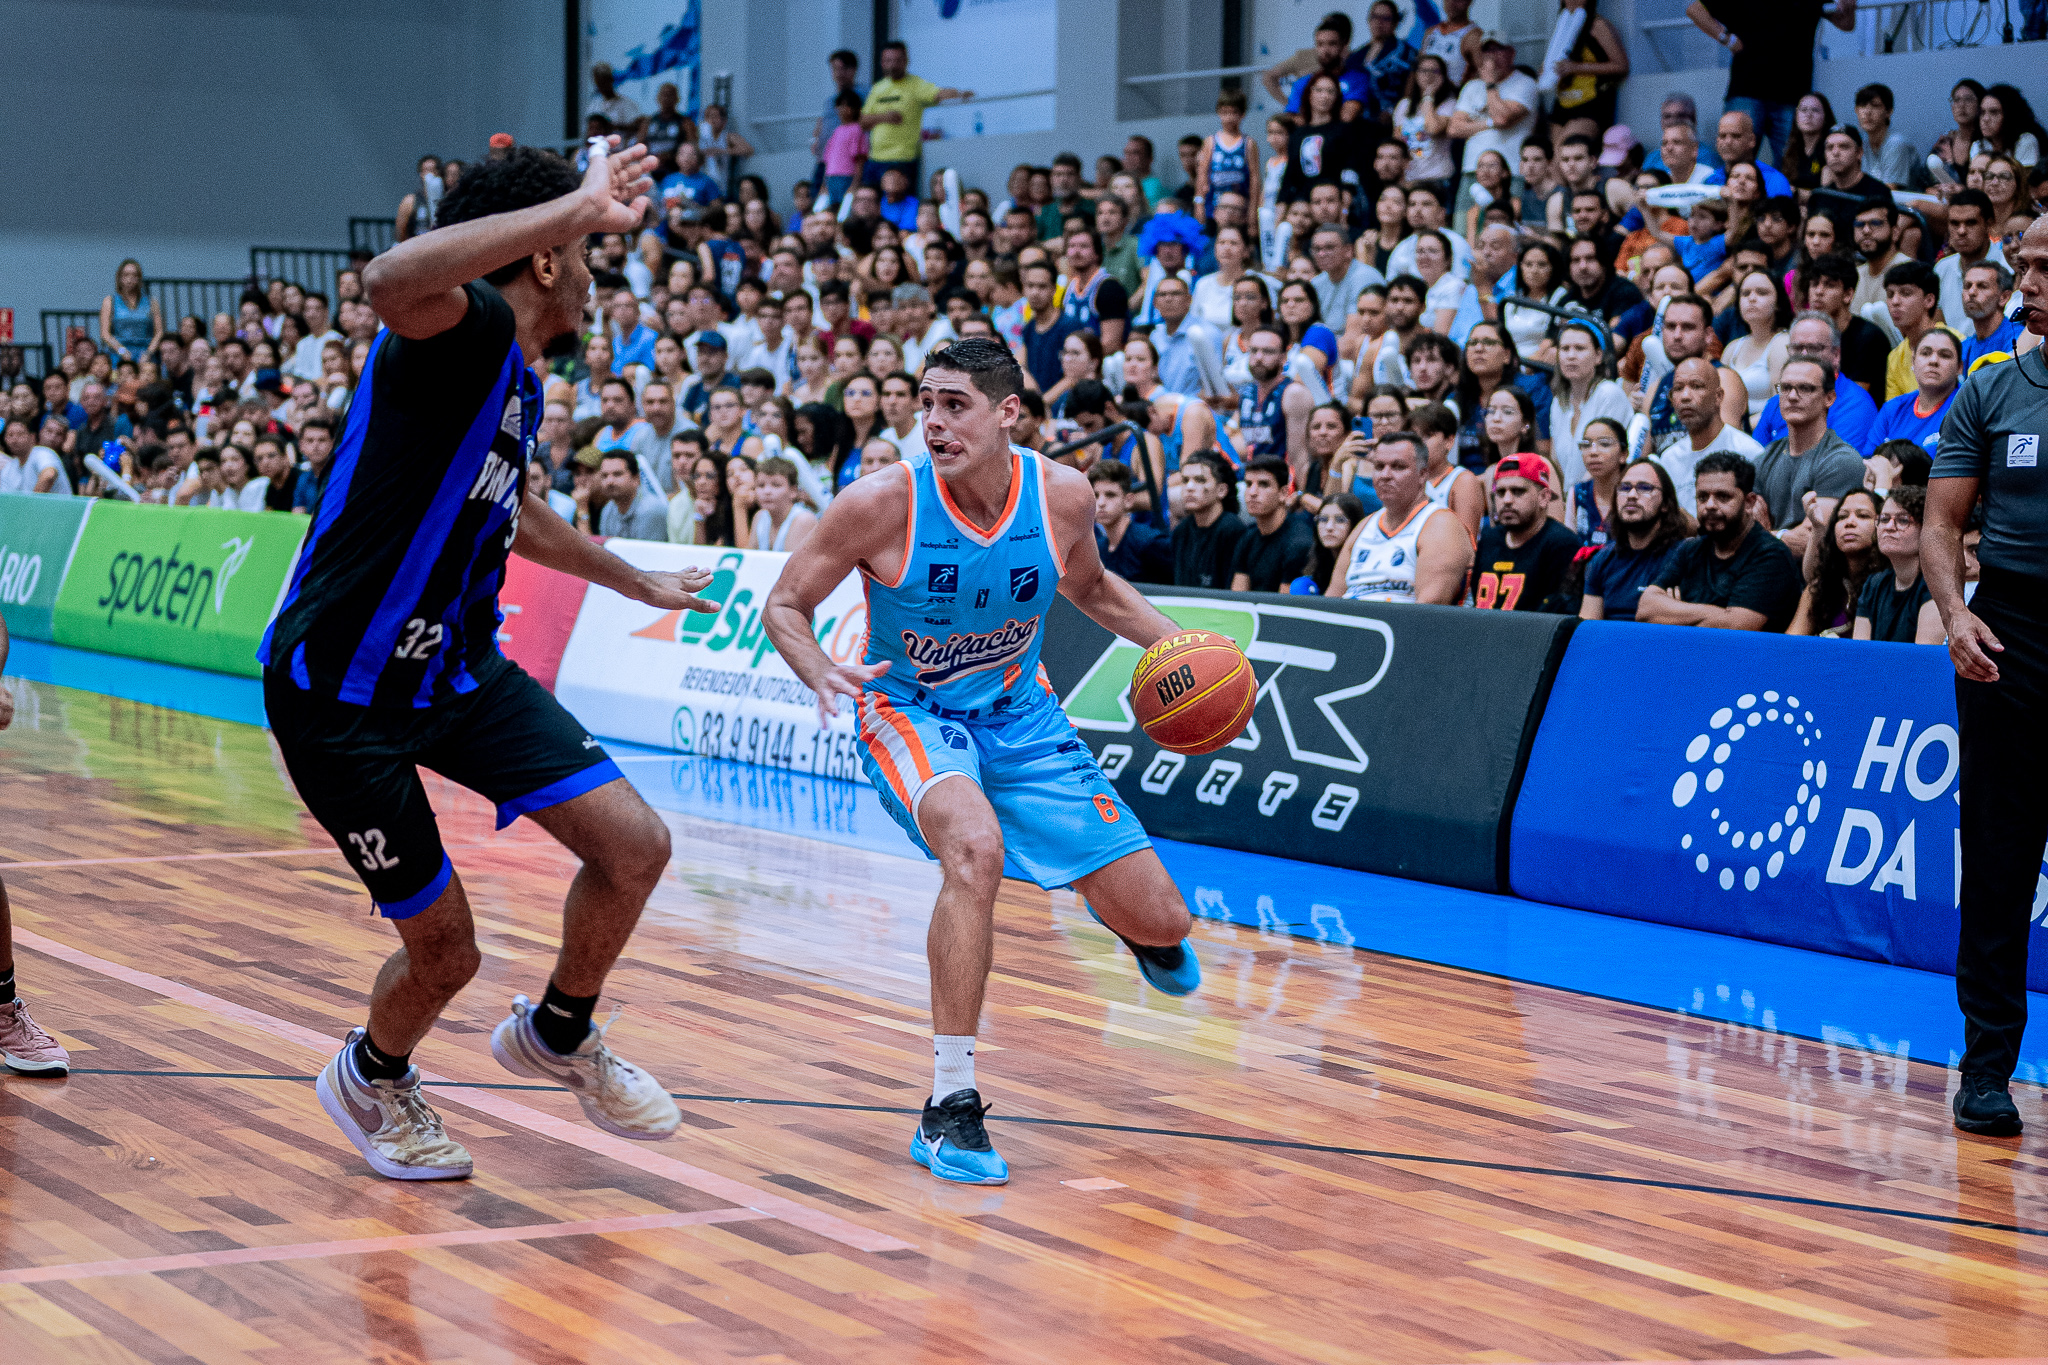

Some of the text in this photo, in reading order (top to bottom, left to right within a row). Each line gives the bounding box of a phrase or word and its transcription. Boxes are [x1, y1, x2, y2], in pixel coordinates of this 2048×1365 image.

[0, 545, 42, 606] RIO
[98, 541, 214, 630] spoten
[394, 617, 443, 660] 32
[901, 614, 1040, 680] Unifacisa
[1131, 633, 1210, 688] PENALTY
[679, 665, 752, 697] REVENDEDOR
[1155, 663, 1196, 707] NBB
[700, 710, 724, 760] 83
[728, 715, 743, 763] 9
[746, 717, 796, 771] 9144
[811, 729, 857, 783] 1155
[1852, 716, 1960, 806] HO
[1092, 793, 1120, 824] 8
[1096, 743, 1360, 832] PORTS
[348, 828, 400, 871] 32
[1826, 807, 1917, 901] DA
